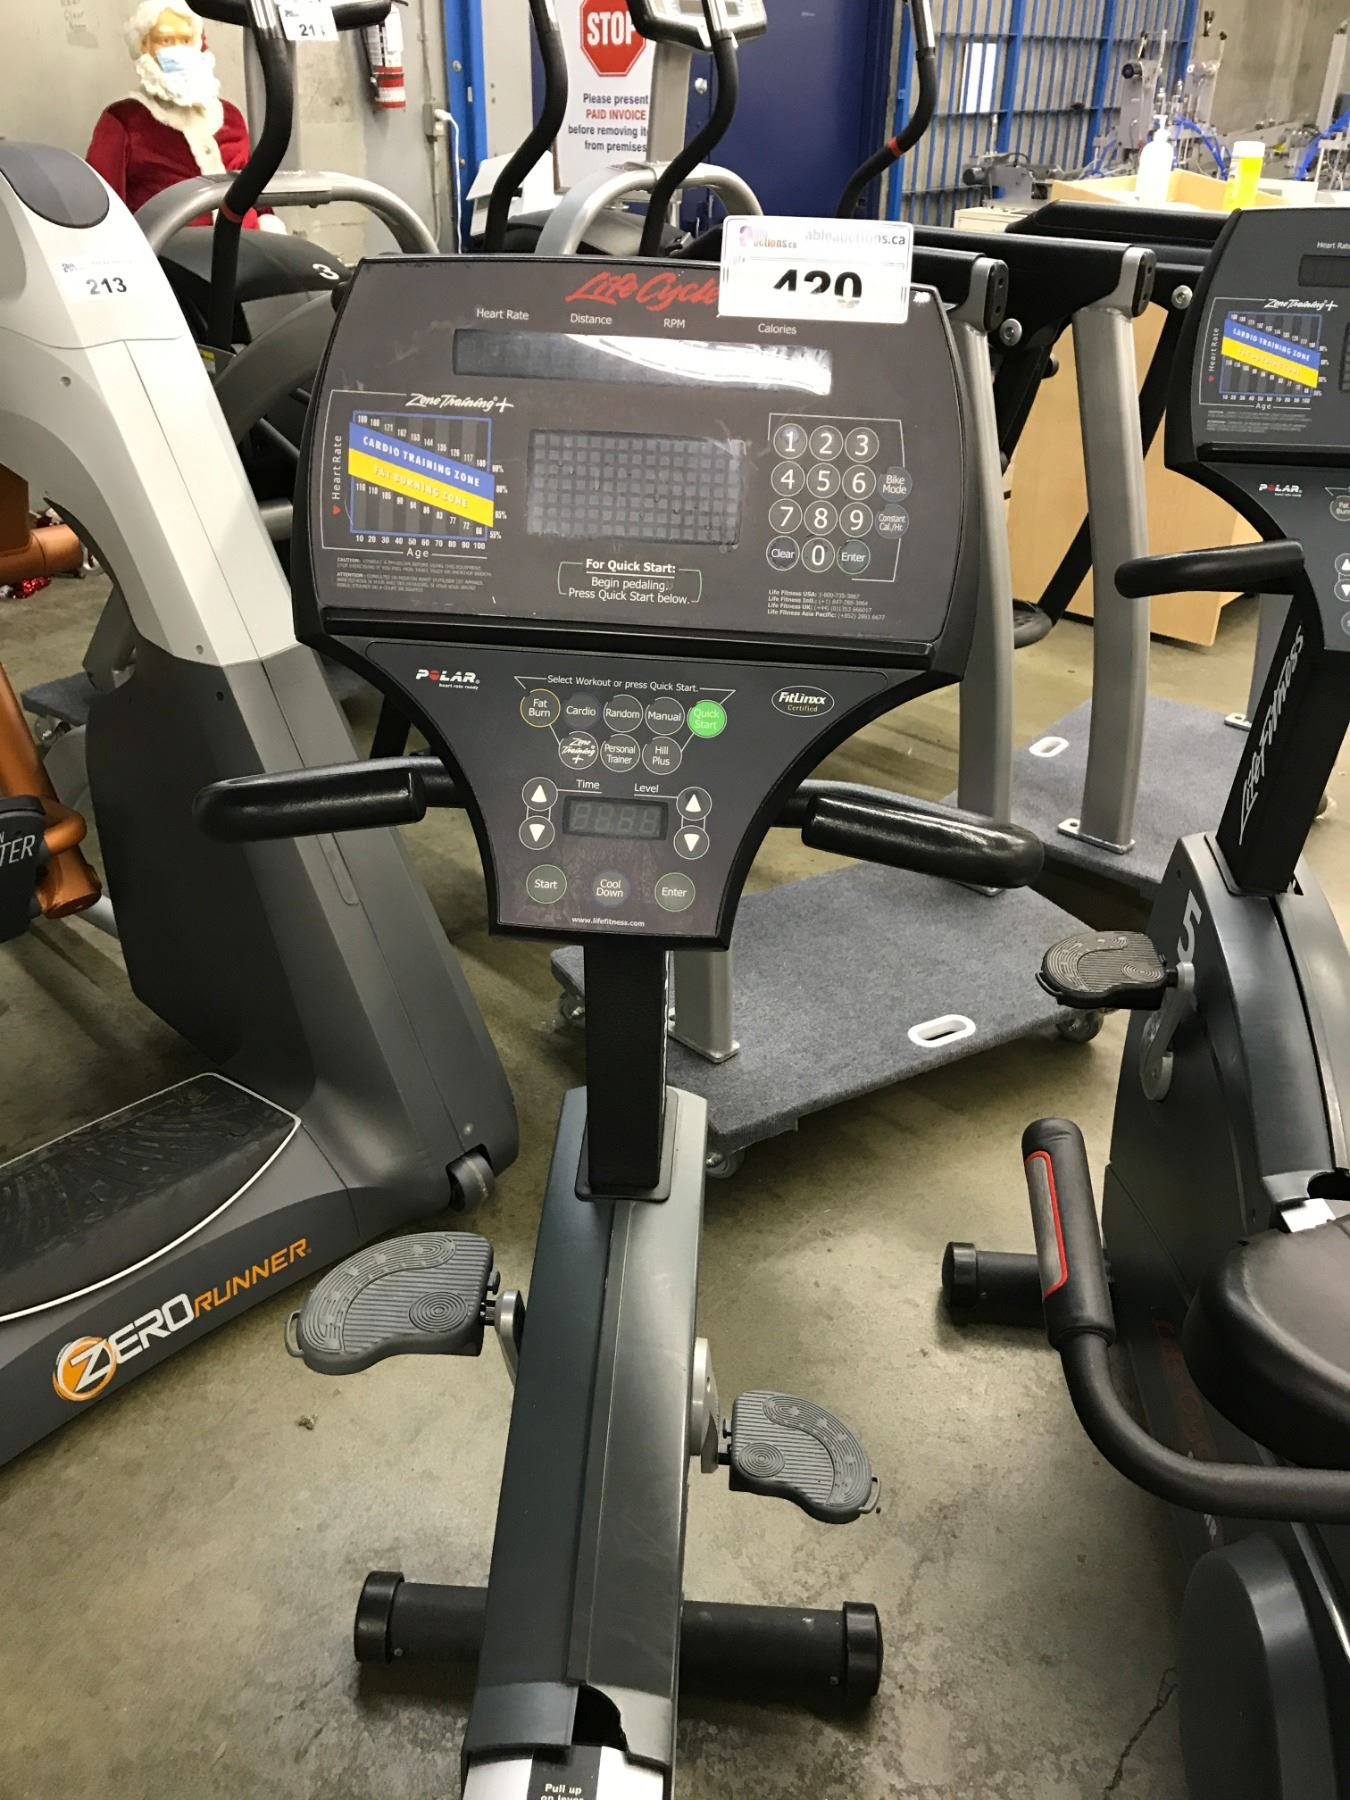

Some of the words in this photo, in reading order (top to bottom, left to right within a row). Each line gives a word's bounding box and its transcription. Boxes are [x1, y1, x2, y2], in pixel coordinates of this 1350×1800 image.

[583, 93, 612, 104] Please
[614, 94, 648, 107] present
[586, 109, 606, 120] PAID
[609, 109, 646, 120] INVOICE
[568, 124, 594, 134] before
[597, 126, 638, 138] removing
[584, 140, 604, 150] from
[607, 142, 648, 152] premises
[86, 277, 127, 295] 213
[476, 308, 503, 320] Heart
[507, 310, 529, 320] Rate
[570, 313, 612, 324] Distance
[664, 318, 686, 329] RPM
[758, 323, 797, 335] Calories
[1256, 402, 1272, 410] Age
[333, 435, 342, 463] Rate
[785, 431, 796, 452] 1
[820, 432, 832, 454] 2
[854, 434, 868, 456] 3
[363, 436, 400, 457] CARDIO
[402, 450, 452, 476] TRAINING
[454, 470, 480, 487] ZONE
[332, 467, 341, 500] Heart
[780, 469, 795, 490] 4
[817, 470, 830, 490] 5
[852, 472, 866, 494] 6
[886, 475, 905, 484] Bike
[882, 484, 907, 494] Mode
[1258, 484, 1300, 493] POLAR
[780, 506, 794, 526] 7
[814, 508, 828, 528] 8
[850, 510, 864, 530] 9
[879, 514, 906, 523] Constant
[356, 534, 364, 542] 10
[368, 536, 376, 544] 20
[381, 536, 390, 544] 30
[406, 548, 430, 558] Age
[771, 549, 794, 558] Clear
[812, 544, 824, 566] 0
[841, 553, 866, 562] Enter
[586, 558, 605, 569] For
[608, 560, 640, 572] Quick
[644, 562, 676, 573] Start:
[592, 577, 619, 589] Begin
[623, 580, 668, 592] pedaling.
[568, 588, 595, 598] Press
[598, 590, 626, 602] Quick
[630, 591, 654, 602] Start
[658, 594, 690, 604] below.
[416, 669, 476, 682] POLAR
[548, 675, 573, 684] Select
[576, 676, 610, 687] Workout
[625, 681, 648, 690] press
[650, 681, 673, 692] Quick
[533, 698, 548, 708] Fat
[787, 704, 818, 713] Certified
[528, 708, 550, 717] Burn
[566, 706, 597, 716] Cardio
[606, 708, 640, 719] Random
[648, 711, 682, 722] Manual
[694, 708, 720, 720] Quick
[694, 720, 717, 730] Start
[604, 744, 636, 754] Personal
[655, 746, 668, 754] Hill
[607, 754, 632, 764] Trainer
[652, 756, 670, 766] Plus
[576, 779, 600, 790] Time
[634, 784, 660, 794] Level
[534, 880, 558, 889] Start
[600, 879, 621, 888] Cool
[596, 888, 624, 898] Down
[662, 887, 688, 897] Enter
[572, 918, 645, 926] www.lifefitness.com
[545, 1784, 566, 1793] Pull
[568, 1787, 582, 1796] up
